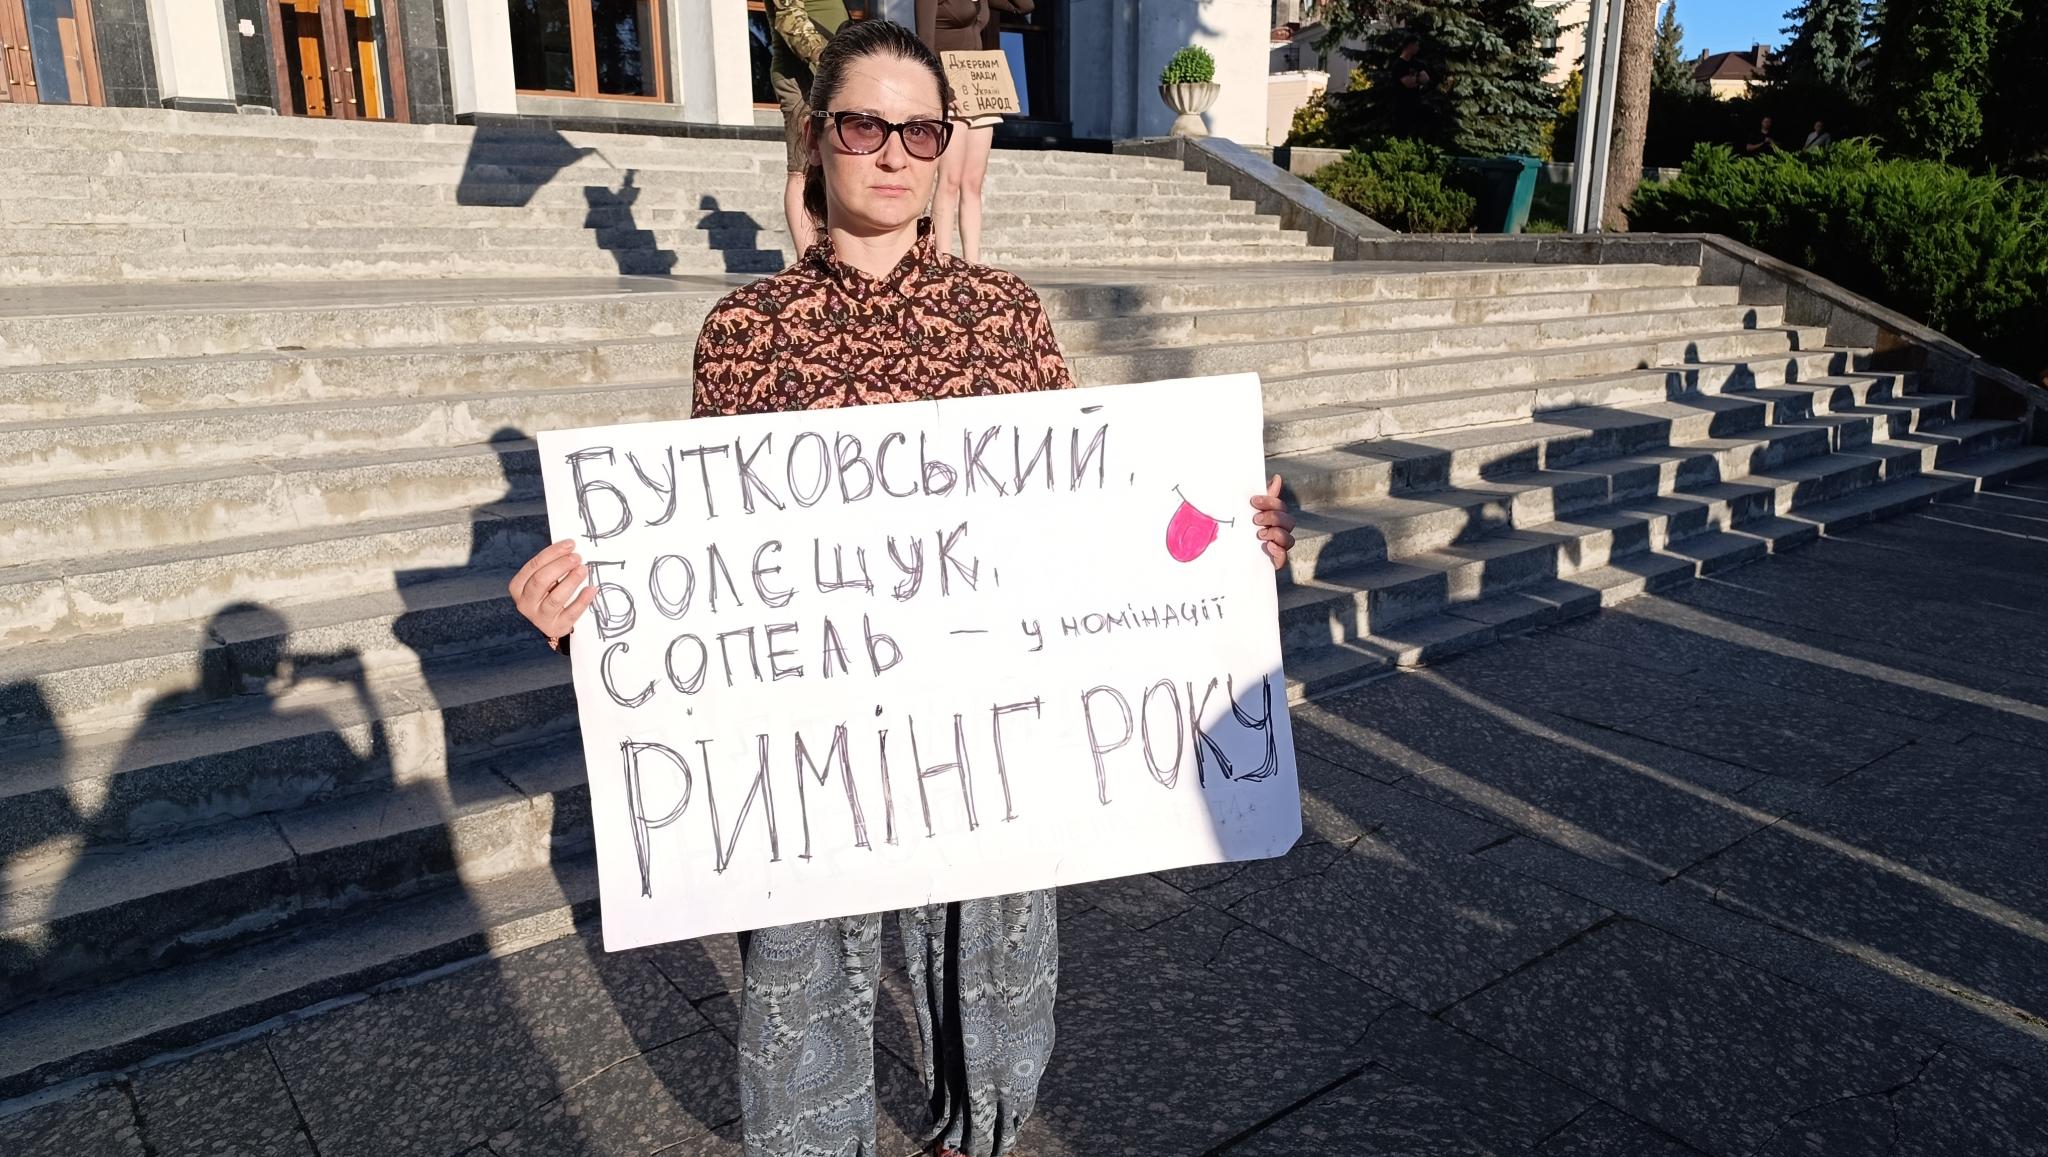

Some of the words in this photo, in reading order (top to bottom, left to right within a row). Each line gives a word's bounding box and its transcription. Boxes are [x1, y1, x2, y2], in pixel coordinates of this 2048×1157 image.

[976, 97, 1012, 111] НАРОД
[600, 612, 904, 708] СОПЕЛЬ
[621, 704, 1045, 899] РИМІНГ
[1081, 673, 1278, 806] РОКУ
